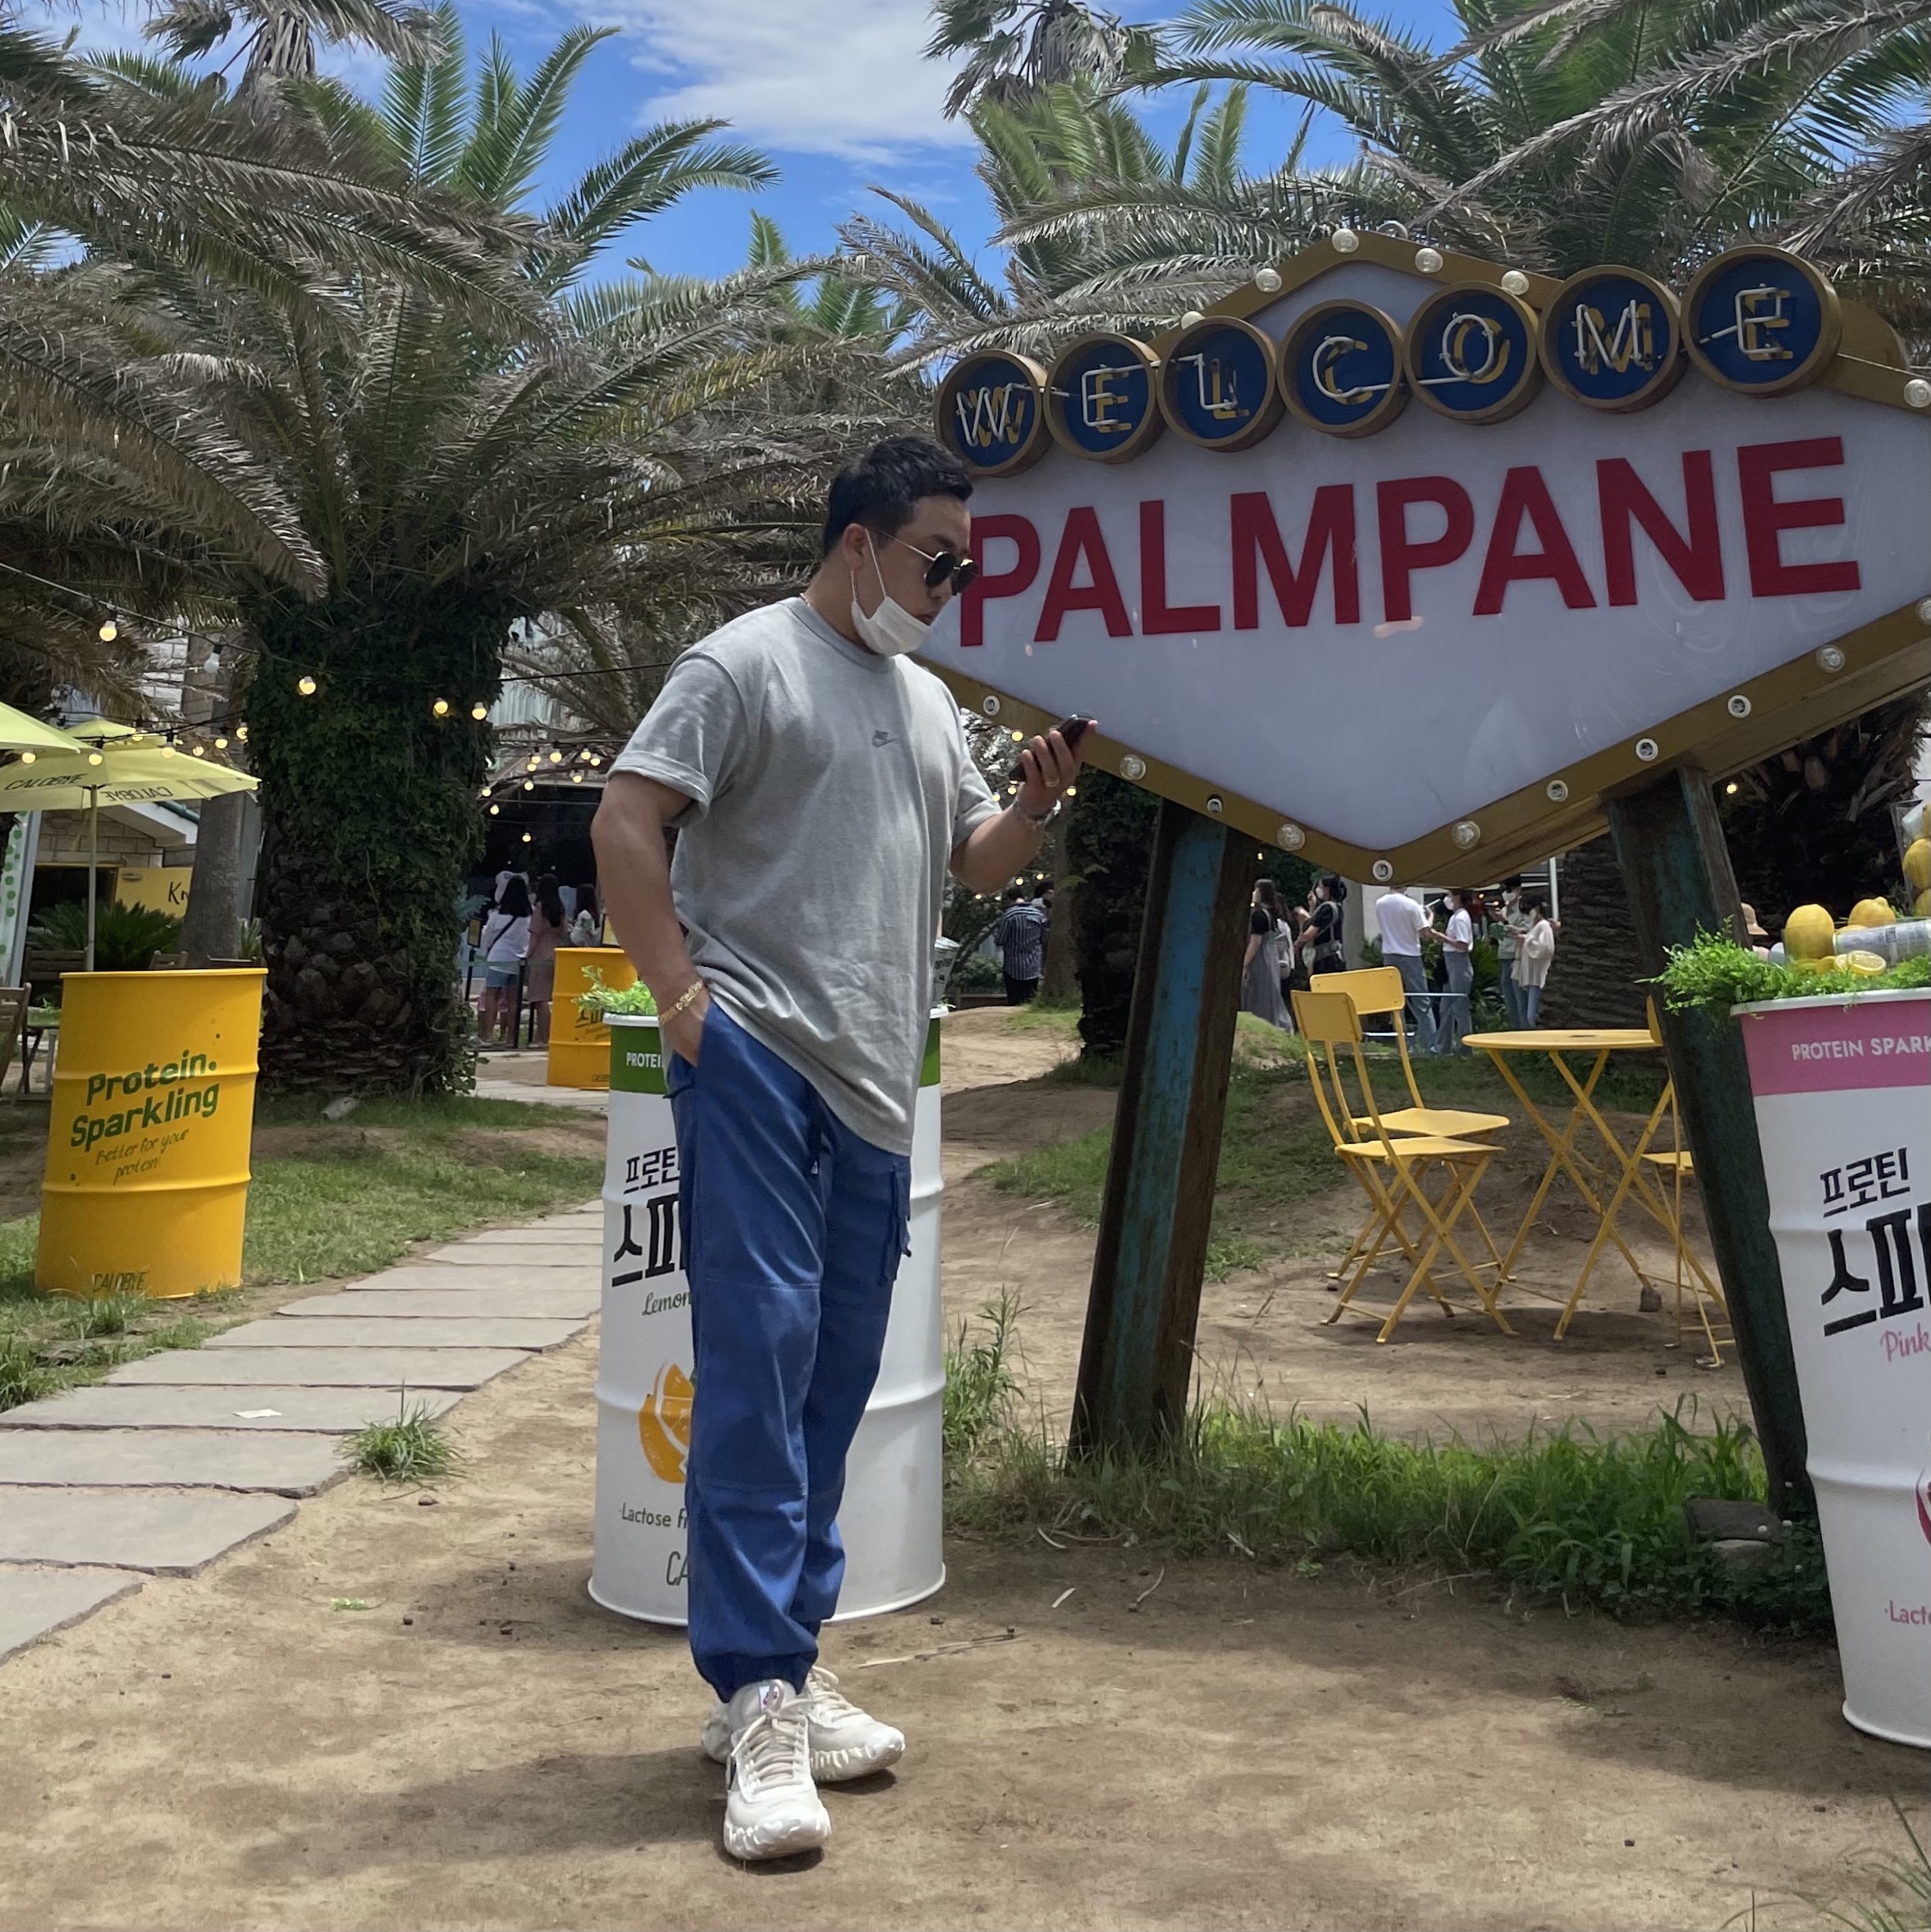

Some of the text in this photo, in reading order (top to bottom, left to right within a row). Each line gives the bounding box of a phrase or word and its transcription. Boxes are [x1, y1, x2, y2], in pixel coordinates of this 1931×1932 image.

[954, 283, 1793, 448] WELCOME
[959, 436, 1861, 647] PALMPANE
[1791, 1039, 1864, 1061] PROTEIN
[71, 1083, 220, 1153] Sparkling
[94, 1129, 190, 1165] Better for your
[623, 1146, 680, 1194] 프로틴
[1819, 1147, 1911, 1218] 프로틴
[642, 1291, 692, 1316] Lemon
[1879, 1321, 1931, 1362] Pink
[621, 1501, 672, 1527] Lactose
[1889, 1599, 1931, 1626] Lact
